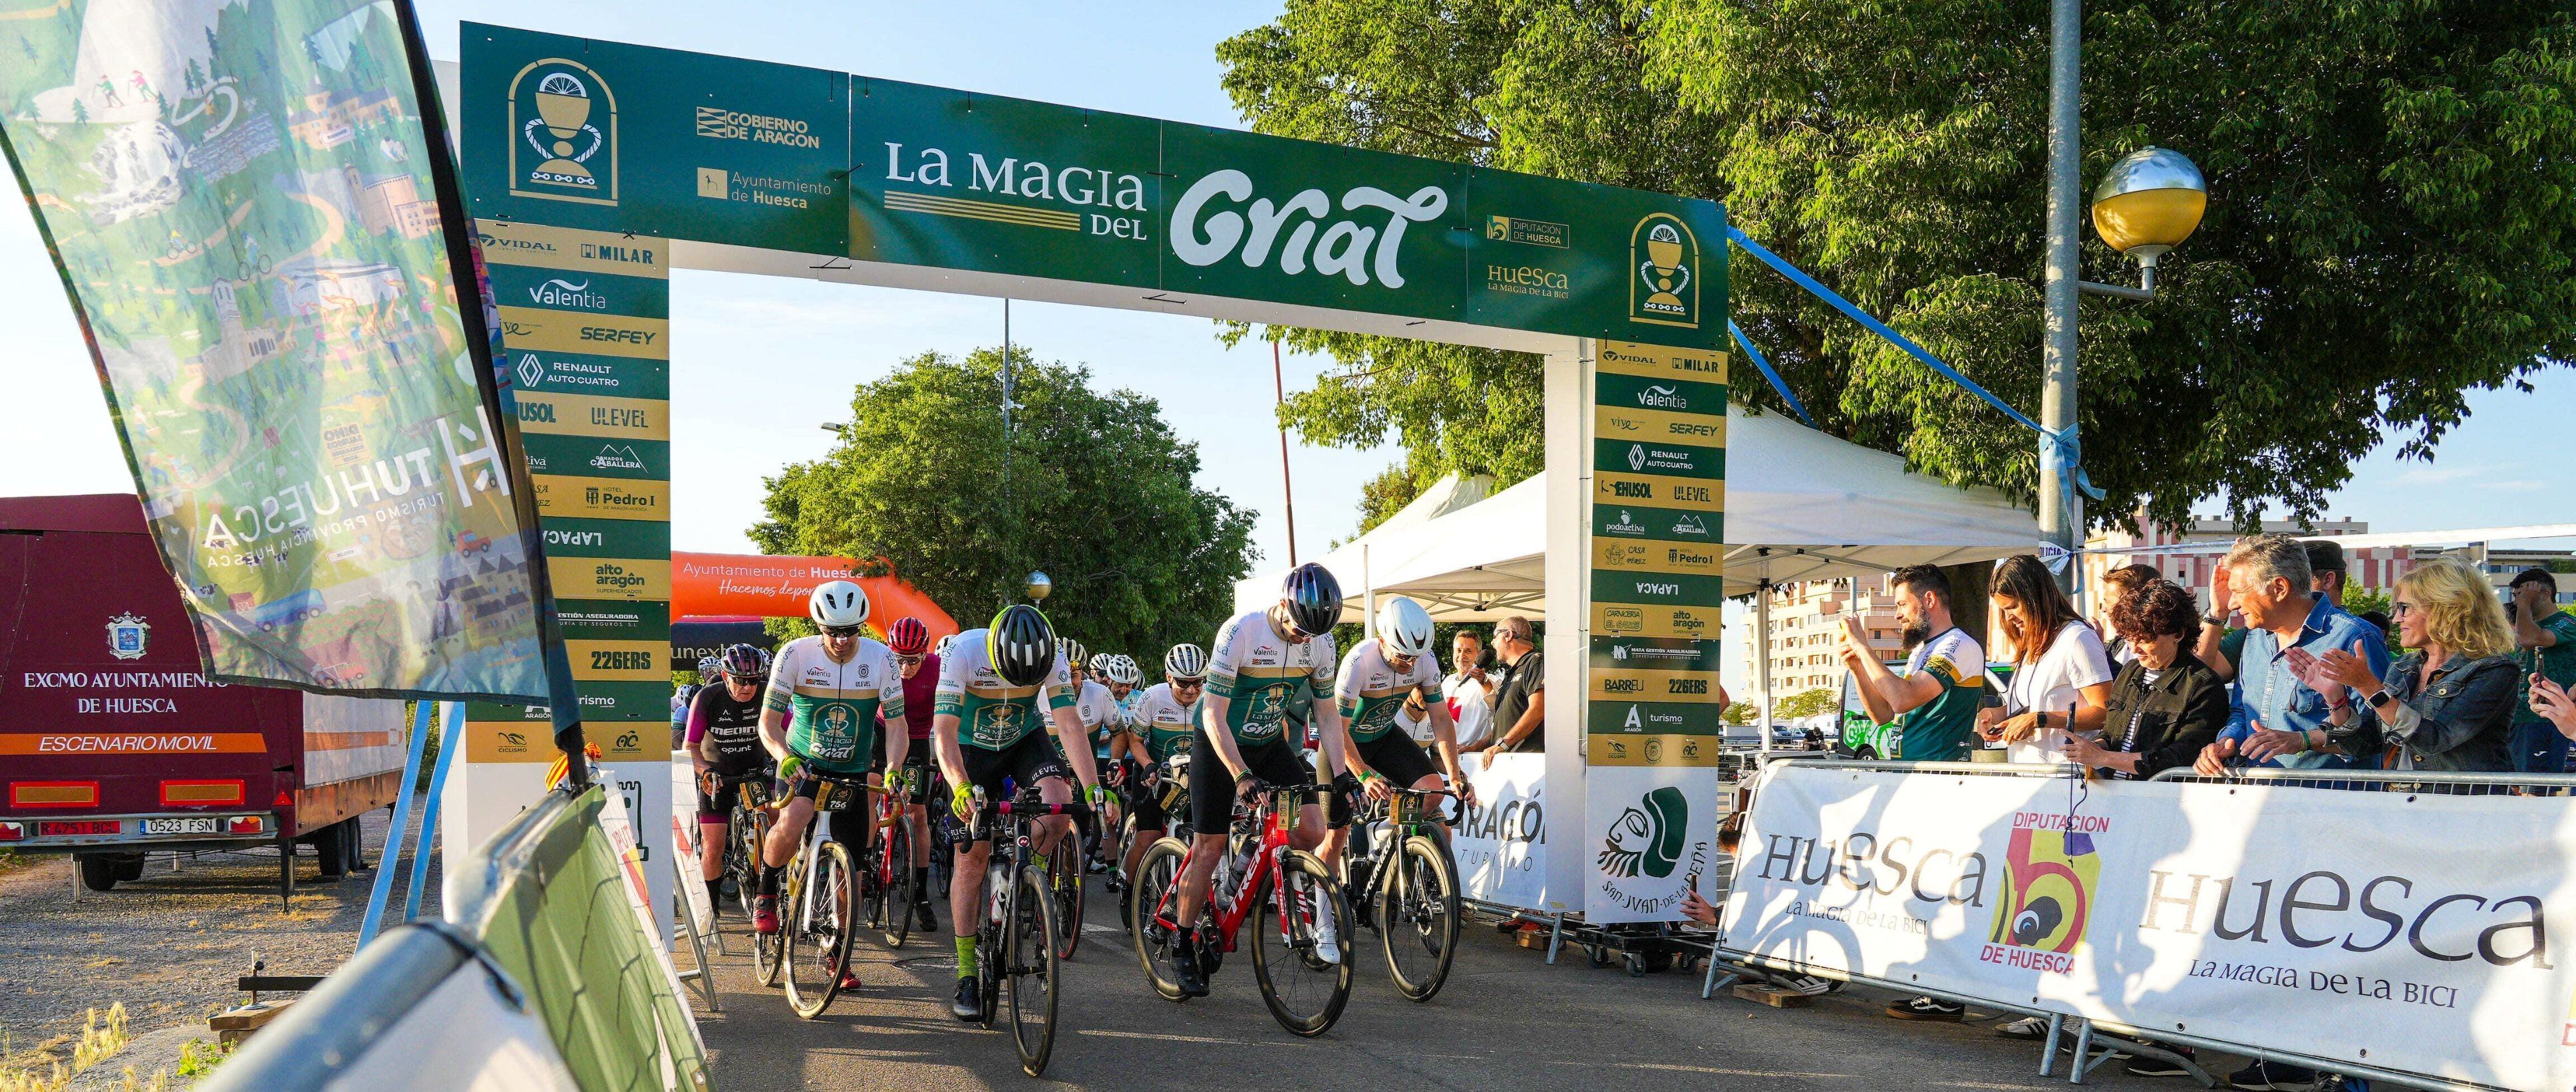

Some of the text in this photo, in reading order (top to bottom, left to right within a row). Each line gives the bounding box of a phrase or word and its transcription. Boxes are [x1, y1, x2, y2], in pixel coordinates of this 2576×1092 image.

[726, 112, 808, 134] GOBIERNO
[727, 125, 820, 148] DE ARAGON
[732, 172, 832, 195] Ayuntamiento
[732, 189, 808, 209] de Huesca
[1169, 168, 1449, 290] Grial
[1514, 221, 1561, 235] DIPUTACIÓN
[498, 238, 557, 251] VIDAL
[1514, 231, 1561, 245] DE HUESCA
[599, 245, 653, 265] MILAR
[1488, 265, 1569, 289] Huesca
[530, 278, 605, 309] Valentia
[1554, 290, 1569, 299] BICI
[499, 318, 532, 336] ive
[580, 327, 657, 345] SERFEY
[1619, 354, 1657, 364] VIDAL
[1684, 358, 1718, 373] MILAR
[554, 362, 611, 374] RENAULT
[1637, 384, 1687, 409] Valentia
[516, 401, 556, 423] USOL
[1669, 422, 1718, 436] SERFEY
[590, 458, 641, 469] CABALLERA
[1651, 451, 1689, 460] RENAULT
[603, 493, 655, 506] Pedro I
[1606, 523, 1645, 533] podoactiva
[1672, 525, 1705, 535] CABALLERA
[1679, 554, 1713, 564] Pedro I
[2038, 547, 2061, 558] OLICIA
[596, 563, 623, 575] alto
[683, 562, 785, 579] Ayuntamiento
[789, 565, 807, 578] de
[718, 578, 818, 601] Hacemos depor
[1636, 583, 1679, 596] LAPACA
[1673, 610, 1690, 619] alto
[1253, 646, 1278, 656] Valentia
[591, 651, 651, 670] 226ERS
[24, 672, 88, 688] EXCMO
[807, 667, 831, 677] Valentia
[1604, 679, 1644, 692] BARREU
[1669, 679, 1708, 694] 226ERS
[78, 698, 178, 714] DE HUESCA
[576, 695, 615, 706] rismo
[1650, 714, 1683, 722] turismo
[39, 735, 218, 752] ESCENARIO MOVIL
[1031, 765, 1060, 781] ULEVEL
[1453, 789, 1545, 845] RAGÓ
[2012, 811, 2110, 833] DIPUTACION
[150, 820, 214, 832] 0523 FSN
[1229, 838, 1268, 914] TREK
[1757, 831, 1989, 908] Huesca
[1903, 916, 1927, 936] BICI
[2138, 869, 2555, 970] Huesca
[1980, 944, 2076, 975] DE HUESCA
[2402, 982, 2459, 1009] BICI
